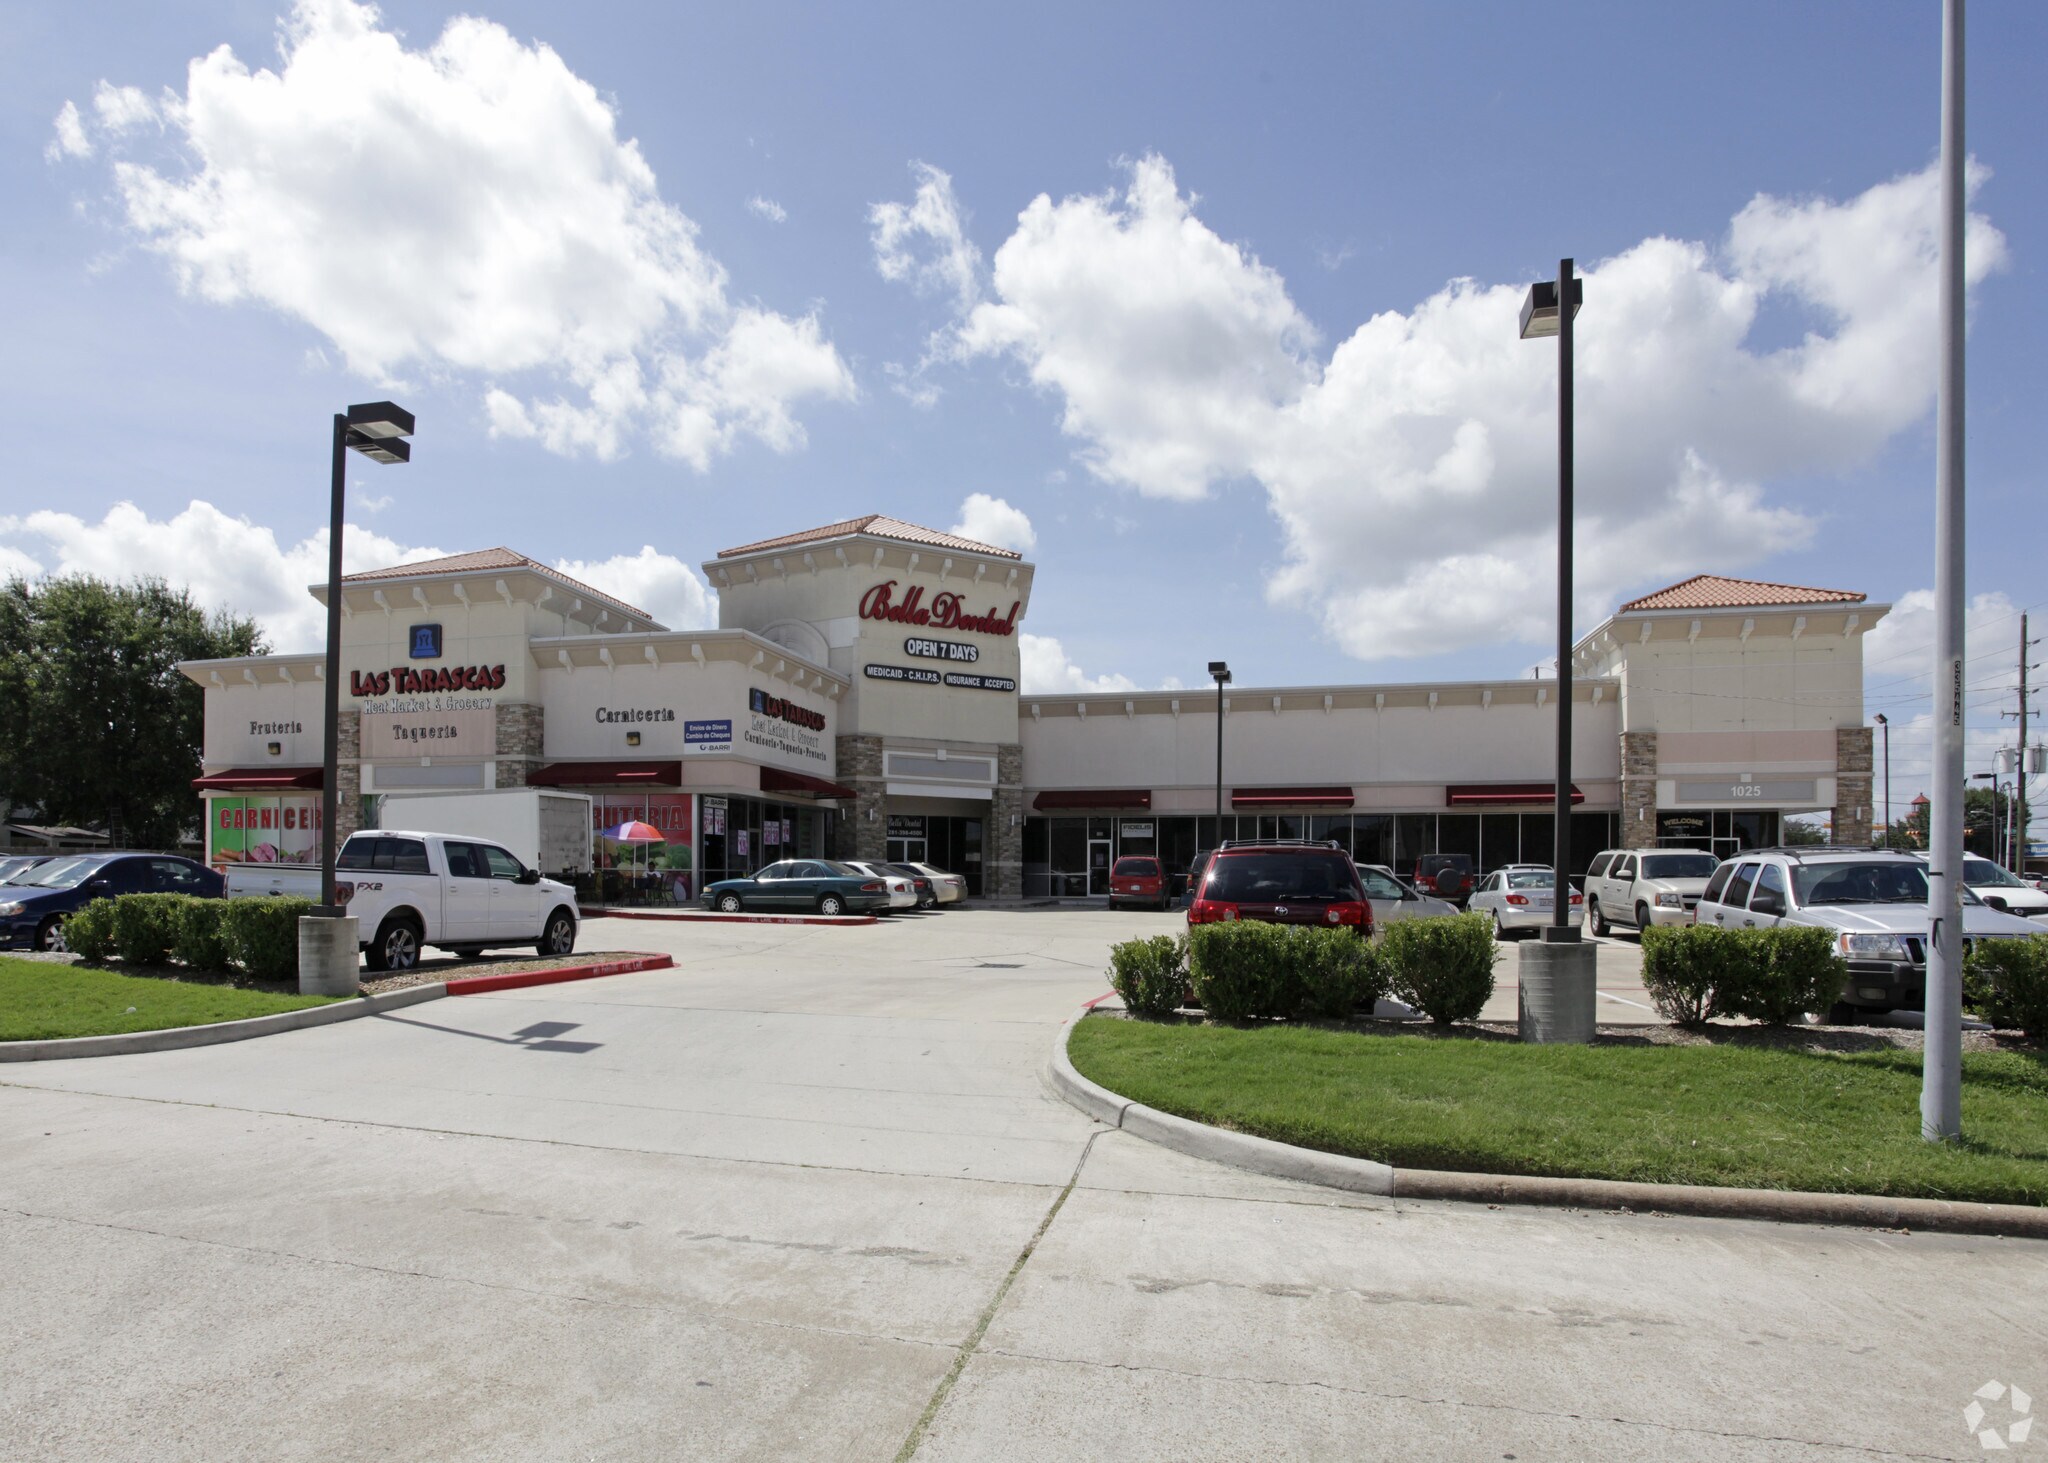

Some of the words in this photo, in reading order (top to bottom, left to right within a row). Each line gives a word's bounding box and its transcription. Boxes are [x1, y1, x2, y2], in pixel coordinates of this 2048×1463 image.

[859, 580, 931, 626] Bella
[928, 591, 1021, 636] Dental
[907, 639, 938, 657] OPEN
[940, 643, 948, 657] 7
[949, 644, 978, 661] DAYS
[350, 669, 391, 697] LAS
[391, 664, 507, 694] TARASCAS
[866, 666, 903, 678] MEDICAID
[946, 674, 981, 687] INSURANCE
[984, 678, 1015, 690] ACCEPTED
[363, 699, 389, 715] Meat
[389, 697, 431, 713] Market
[435, 697, 442, 712] &
[446, 696, 492, 711] Grocery
[595, 706, 675, 724] Carniceria
[249, 721, 303, 735] Fruteria
[392, 724, 458, 743] Taqueria
[1730, 785, 1761, 797] 1025
[220, 806, 323, 830] CARNICER
[593, 805, 686, 831] RUTERIA
[1663, 818, 1704, 826] WELCOME
[356, 882, 384, 892] FX2
